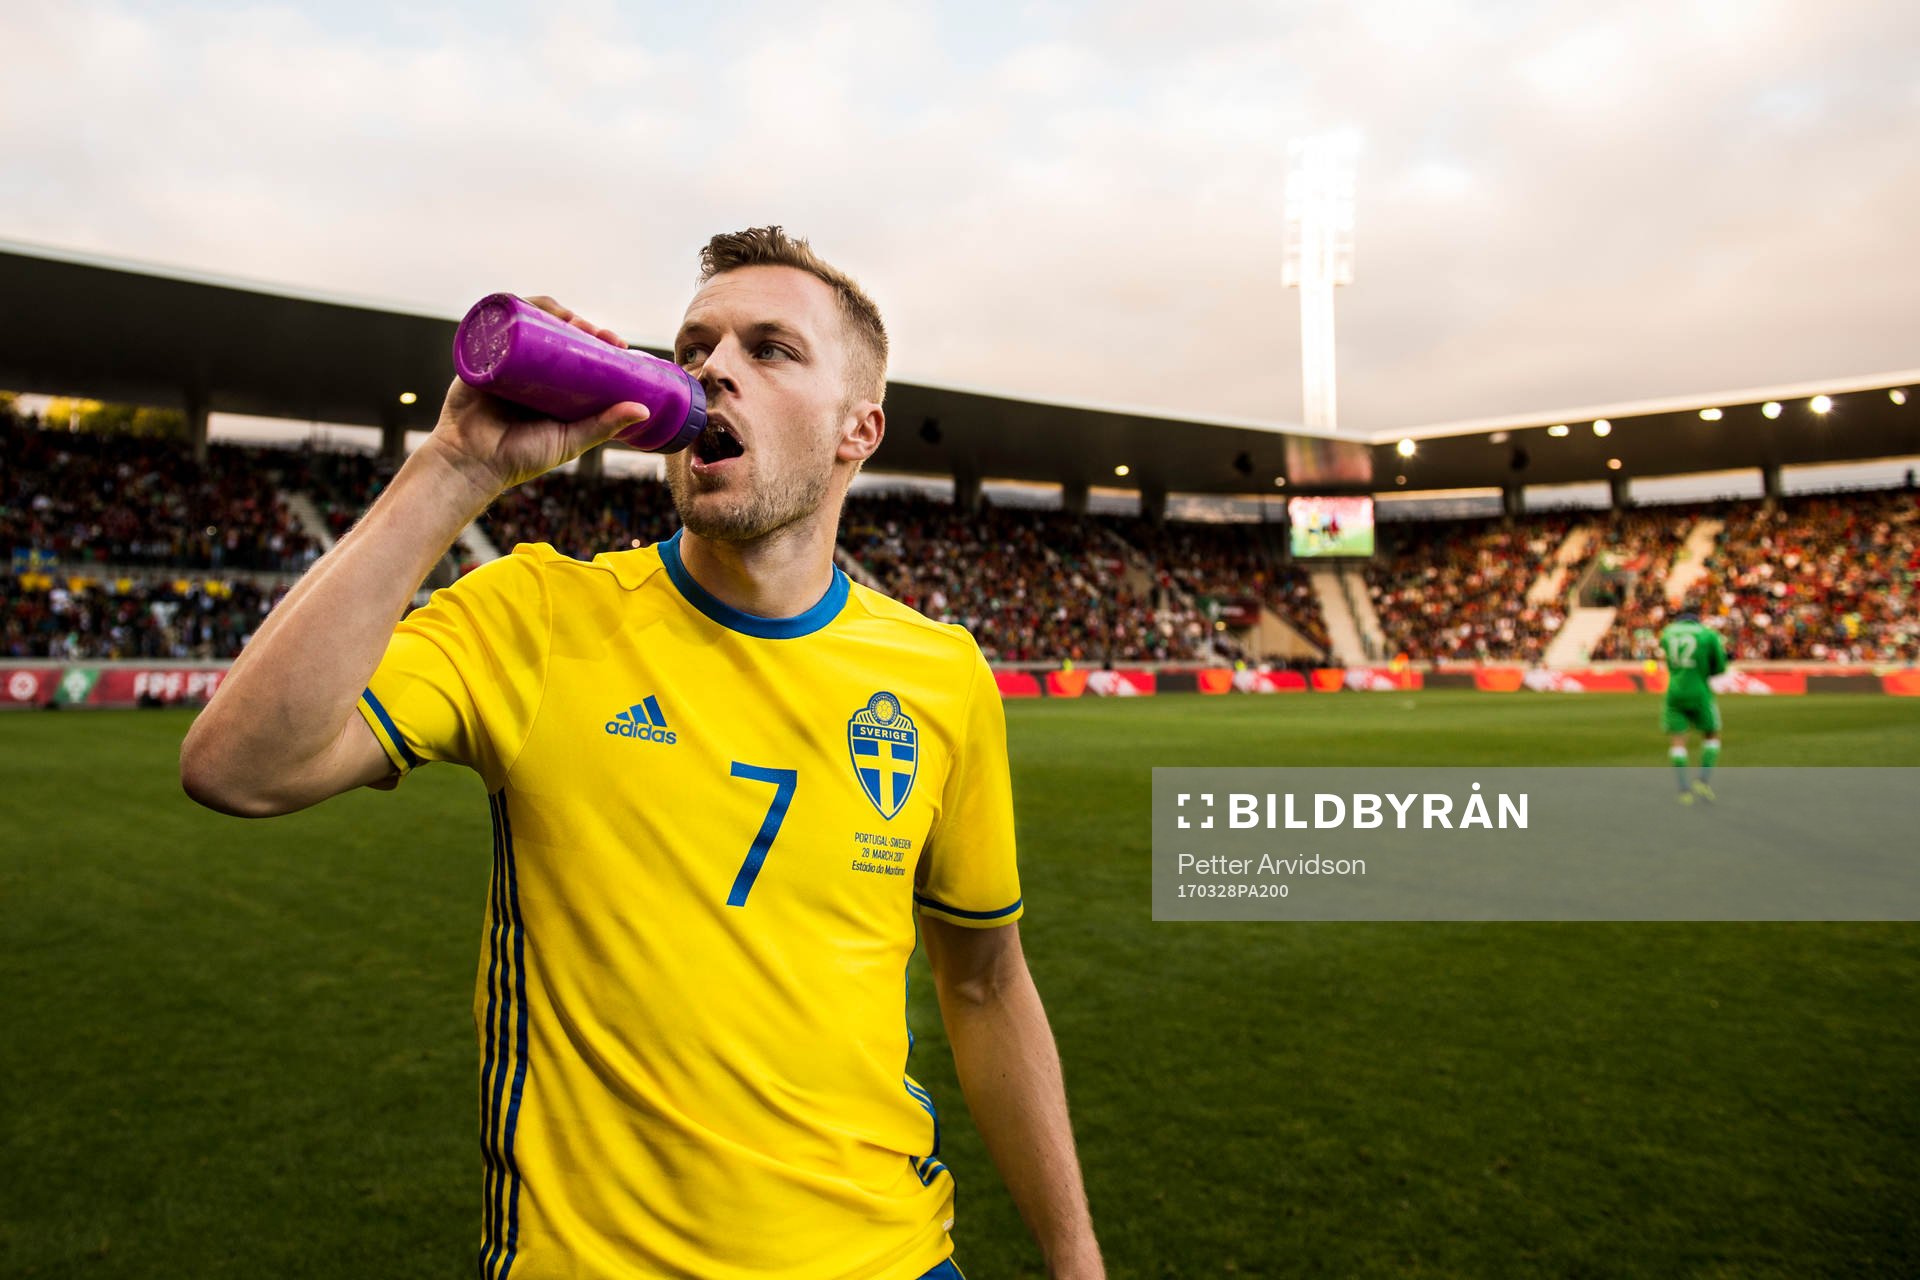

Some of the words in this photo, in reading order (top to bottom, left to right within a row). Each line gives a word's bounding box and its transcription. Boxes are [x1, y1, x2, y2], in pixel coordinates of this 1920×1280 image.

[1668, 633, 1697, 669] 12
[605, 721, 677, 745] adidas
[860, 726, 908, 741] SVERIGE
[726, 760, 797, 907] 7
[862, 847, 870, 858] 28
[872, 849, 893, 861] MARCH
[876, 864, 884, 874] do
